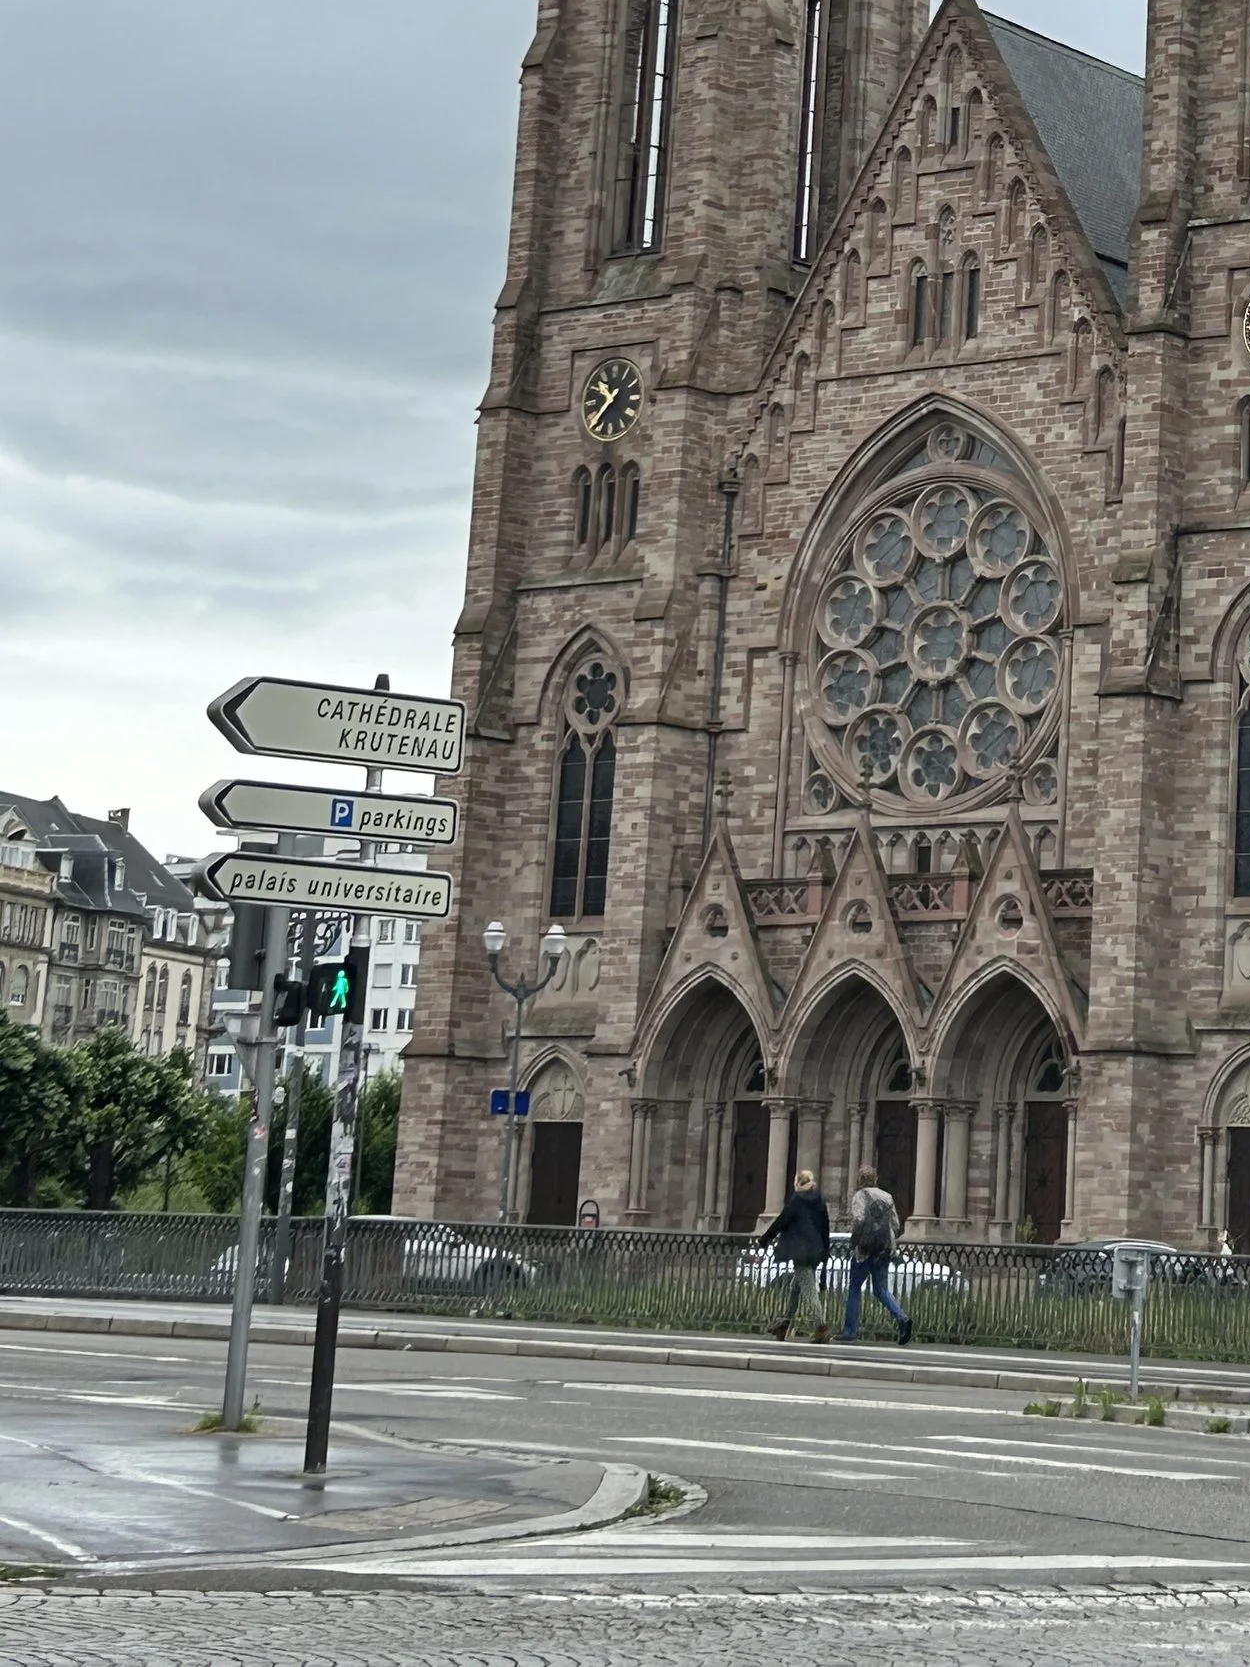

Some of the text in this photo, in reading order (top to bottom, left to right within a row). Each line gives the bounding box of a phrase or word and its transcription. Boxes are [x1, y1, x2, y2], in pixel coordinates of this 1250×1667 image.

[317, 698, 457, 733] CATHÉDRALE
[338, 728, 455, 760] KRUTENAU
[335, 802, 448, 836] P parkings
[229, 869, 442, 905] palais universitaire
